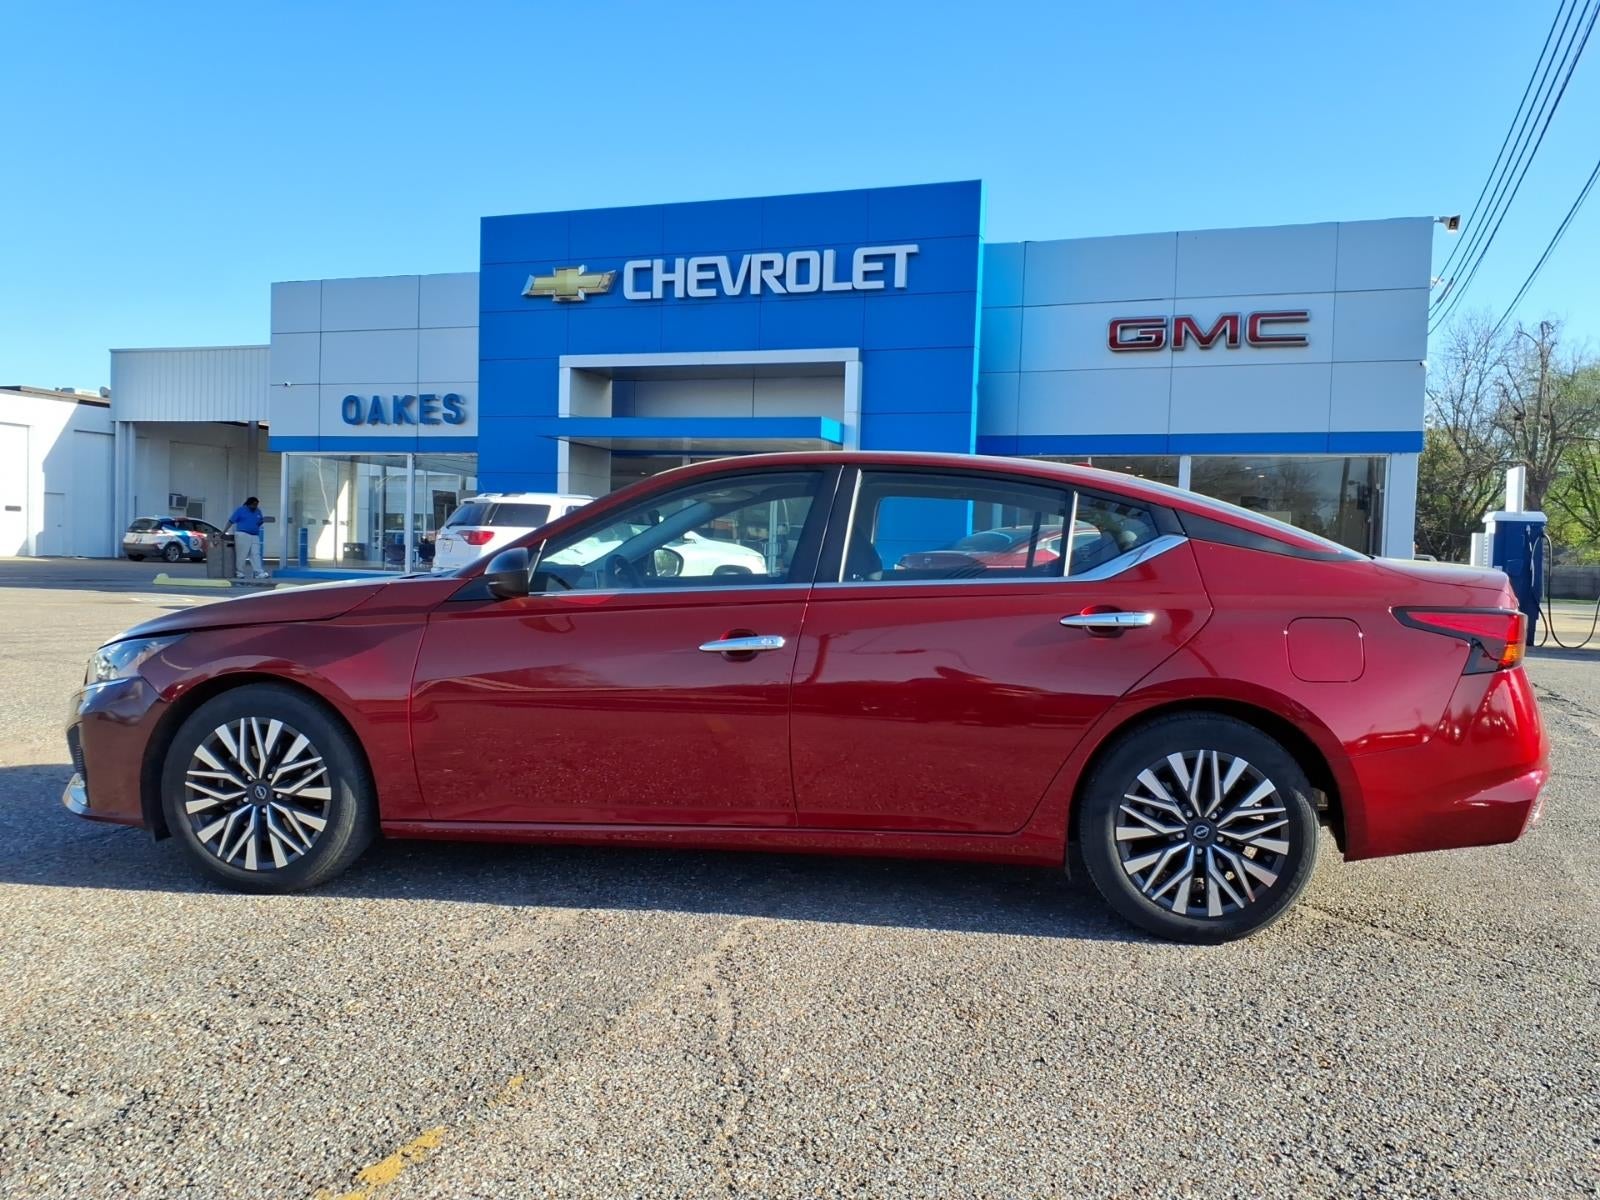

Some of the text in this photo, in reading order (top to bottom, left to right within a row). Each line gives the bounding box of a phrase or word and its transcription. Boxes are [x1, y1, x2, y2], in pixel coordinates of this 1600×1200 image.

[623, 244, 919, 300] CHEVROLET
[1108, 309, 1310, 351] GMC
[342, 393, 466, 425] OAKES
